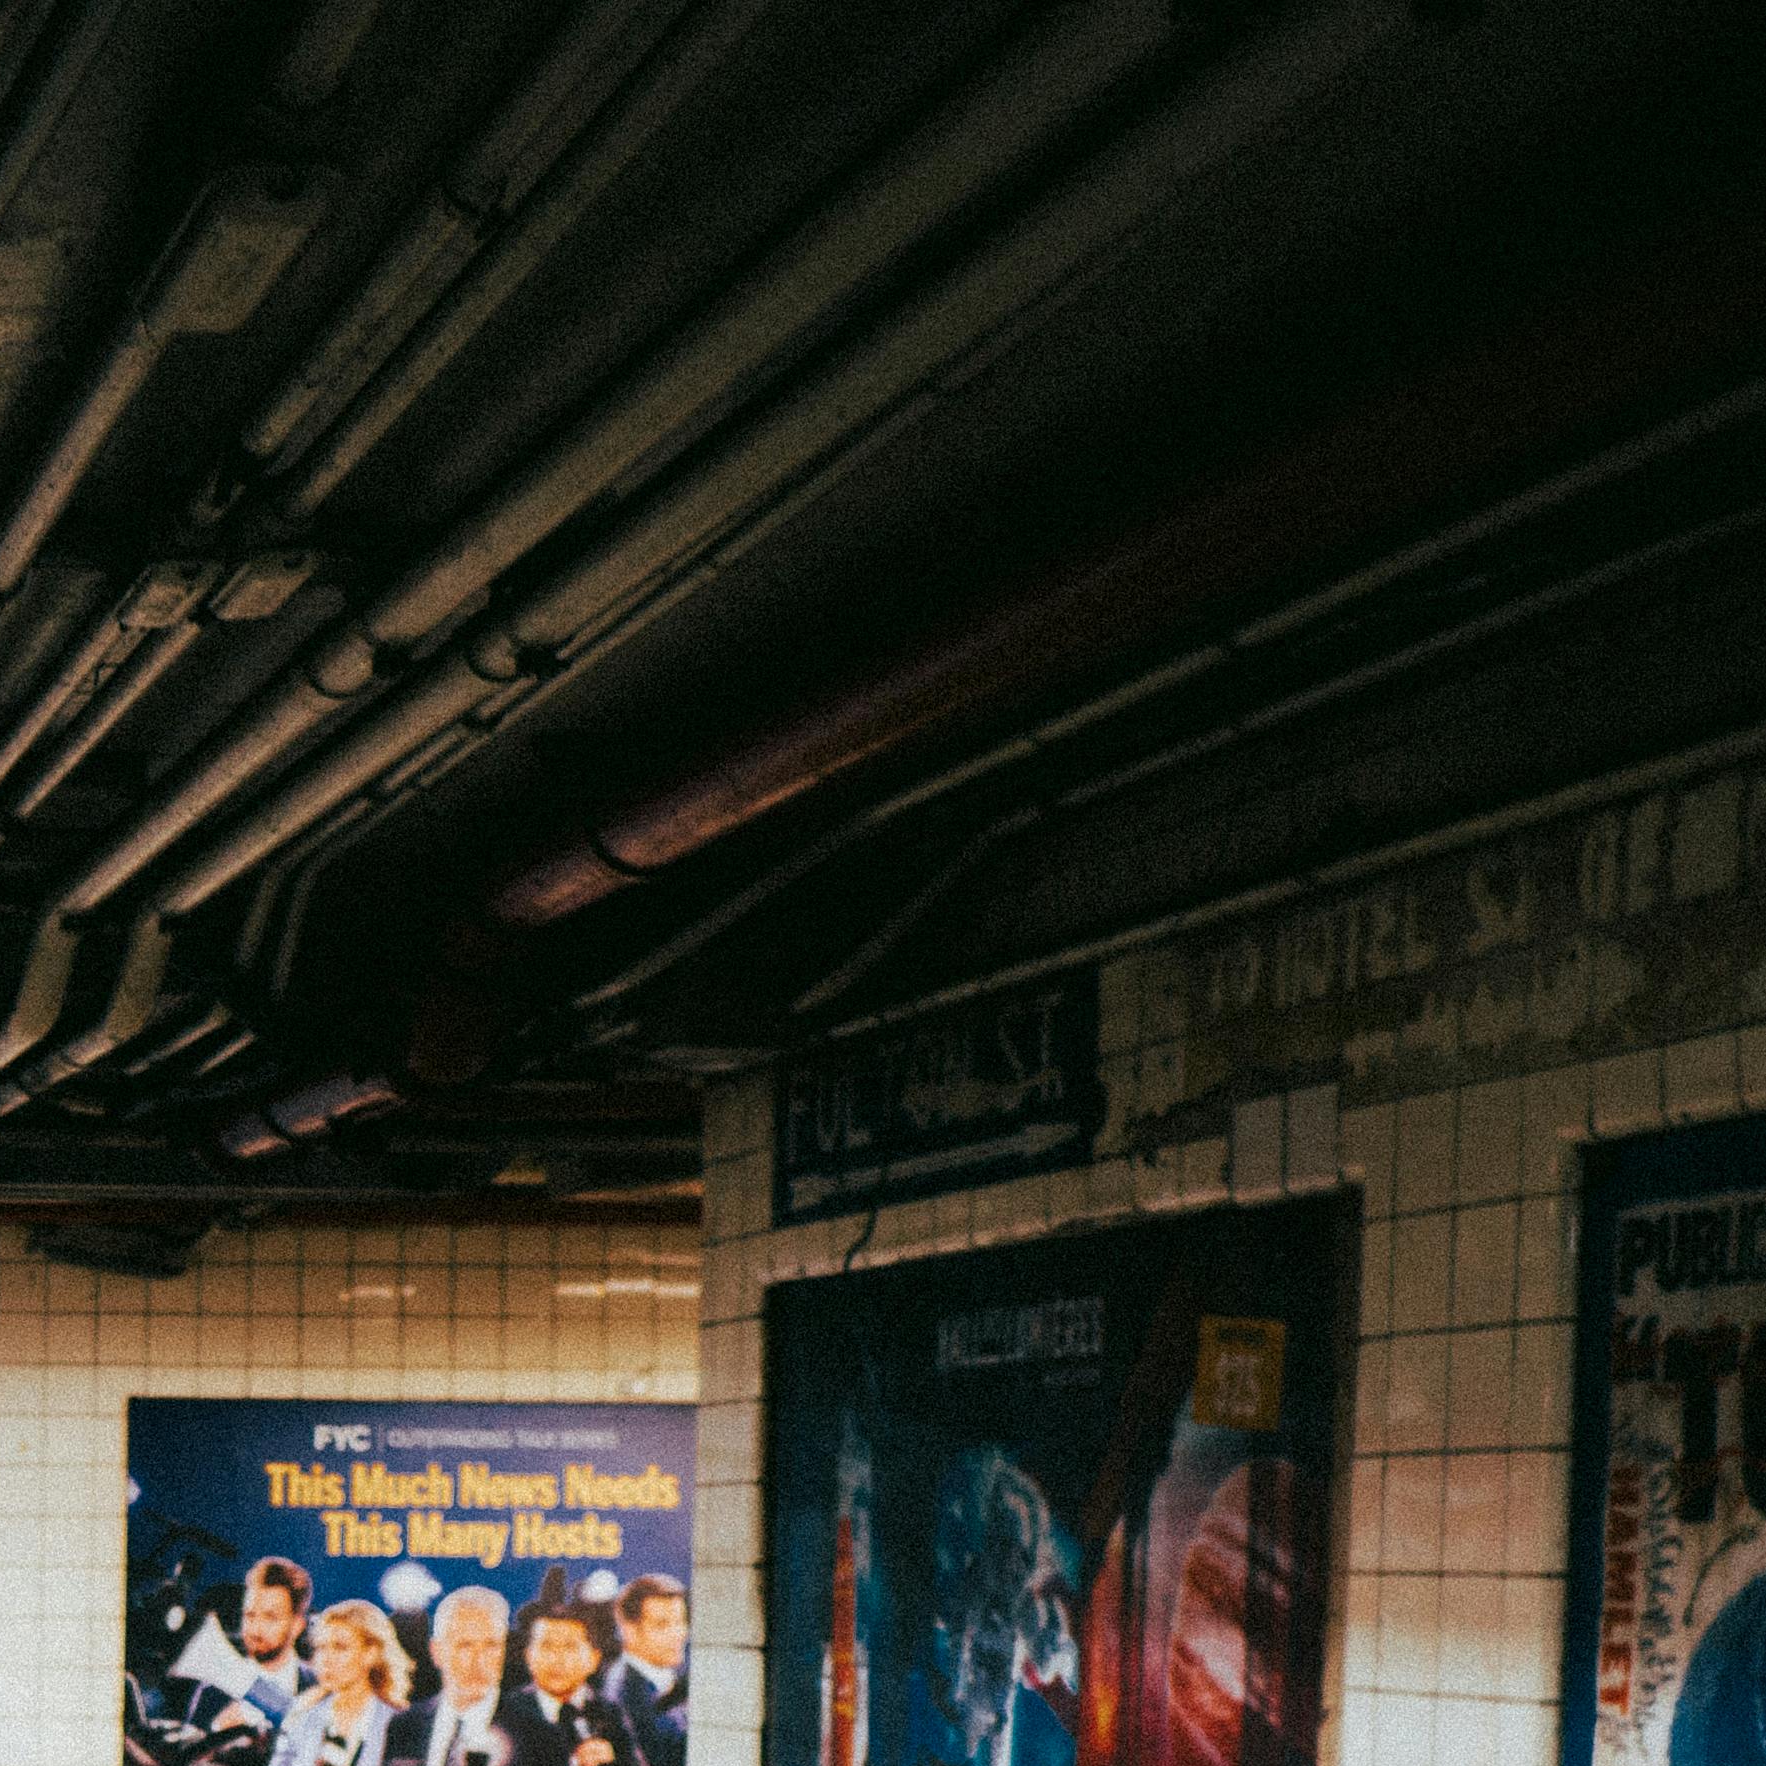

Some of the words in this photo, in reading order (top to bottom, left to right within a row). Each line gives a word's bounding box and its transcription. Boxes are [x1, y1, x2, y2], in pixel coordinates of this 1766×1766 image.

[313, 1424, 371, 1452] FYC
[266, 1463, 345, 1508] This
[350, 1464, 451, 1508] Much
[459, 1465, 557, 1508] News
[565, 1465, 679, 1509] Needs
[321, 1511, 402, 1557] This
[408, 1513, 510, 1568] Many
[514, 1513, 622, 1558] Hosts
